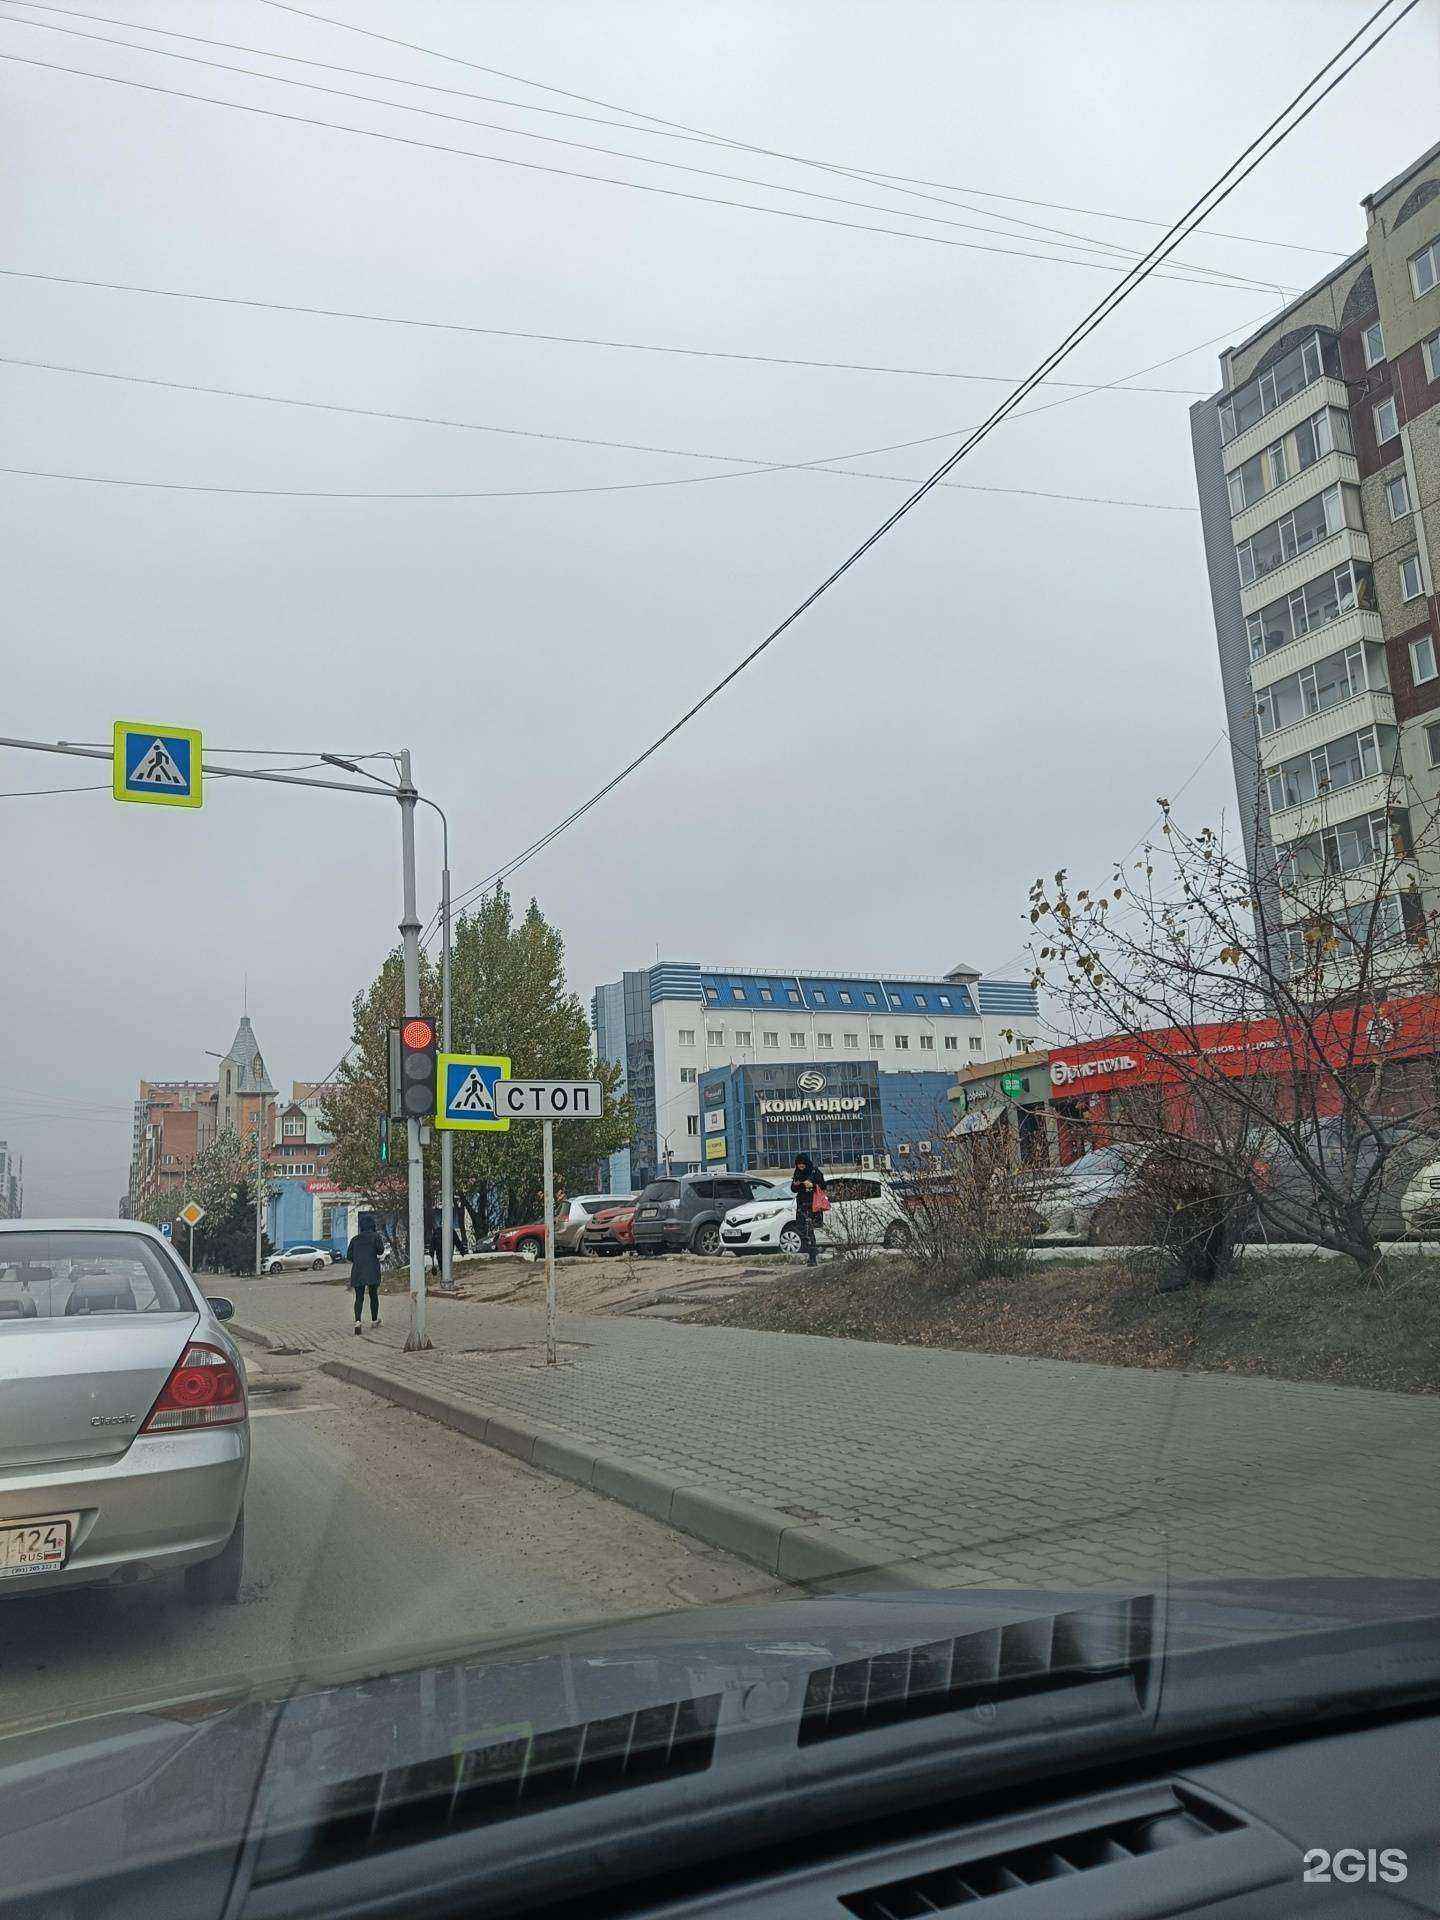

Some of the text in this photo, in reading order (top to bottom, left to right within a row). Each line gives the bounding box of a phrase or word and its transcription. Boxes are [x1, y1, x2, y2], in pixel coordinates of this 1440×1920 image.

[507, 1087, 590, 1111] СТОП
[760, 1097, 866, 1114] КОМАНДОР
[766, 1113, 864, 1123] ТОРГОВЫЙ КОМПЛЕКС
[90, 1413, 137, 1427] Classic
[15, 1527, 57, 1553] 124
[19, 1552, 45, 1562] RUS
